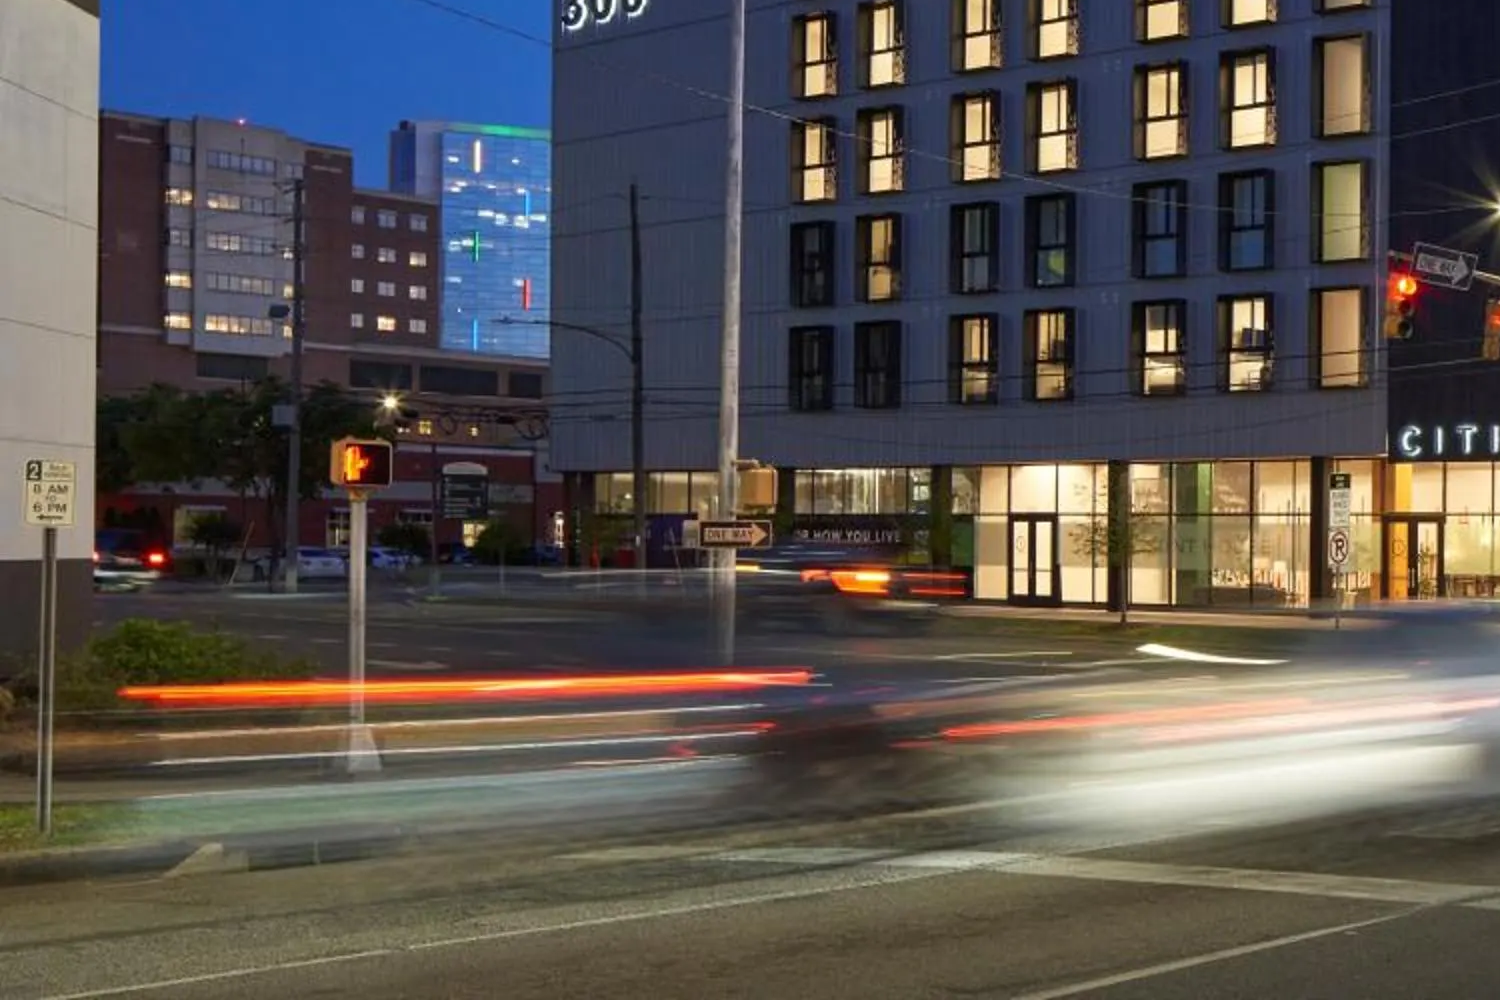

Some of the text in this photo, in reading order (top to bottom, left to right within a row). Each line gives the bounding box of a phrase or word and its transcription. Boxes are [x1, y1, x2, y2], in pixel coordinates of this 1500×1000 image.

[29, 463, 39, 479] 2
[48, 484, 69, 494] AM
[48, 503, 67, 513] PM
[708, 529, 725, 540] ONE
[846, 529, 871, 543] YOU
